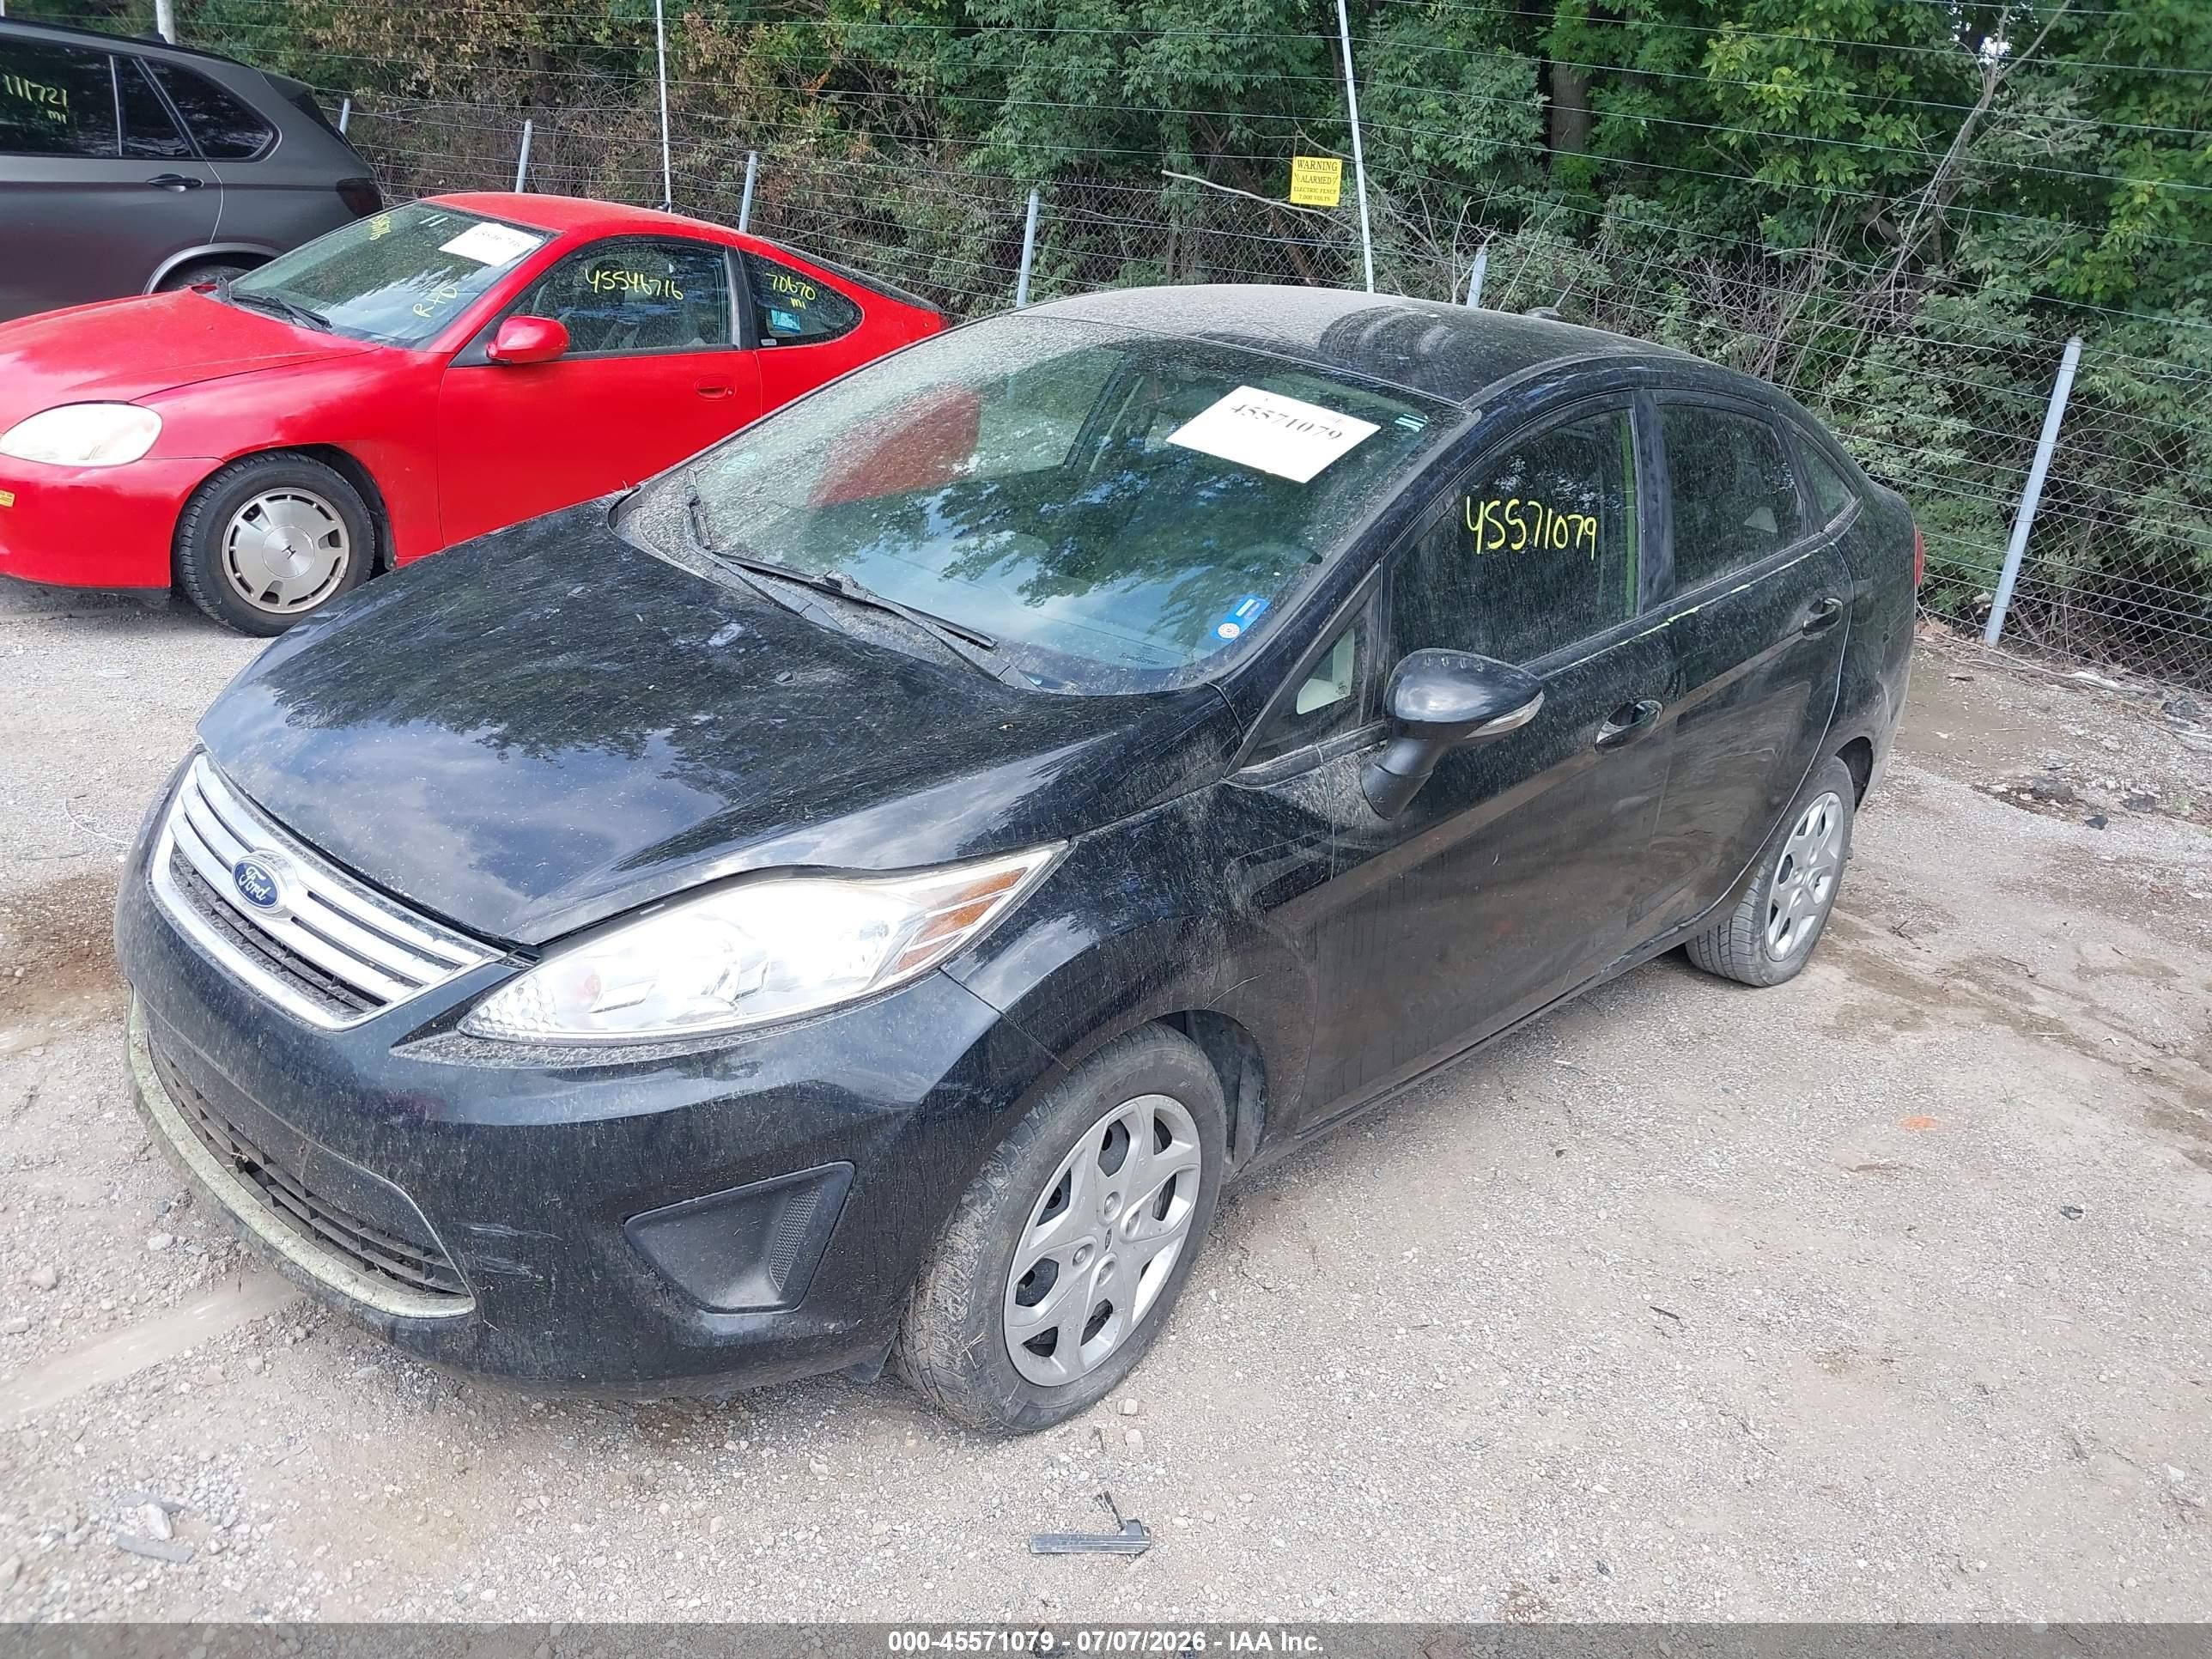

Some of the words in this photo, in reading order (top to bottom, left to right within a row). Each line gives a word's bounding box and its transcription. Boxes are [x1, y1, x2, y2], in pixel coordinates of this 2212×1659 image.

[1297, 159, 1338, 172] WARNING
[1301, 174, 1332, 185] ALARMED
[585, 268, 684, 301] 45546716
[766, 272, 816, 301] 70670
[1230, 404, 1343, 440] 45571079
[1466, 495, 1597, 562] 45571079
[239, 866, 272, 902] Ford
